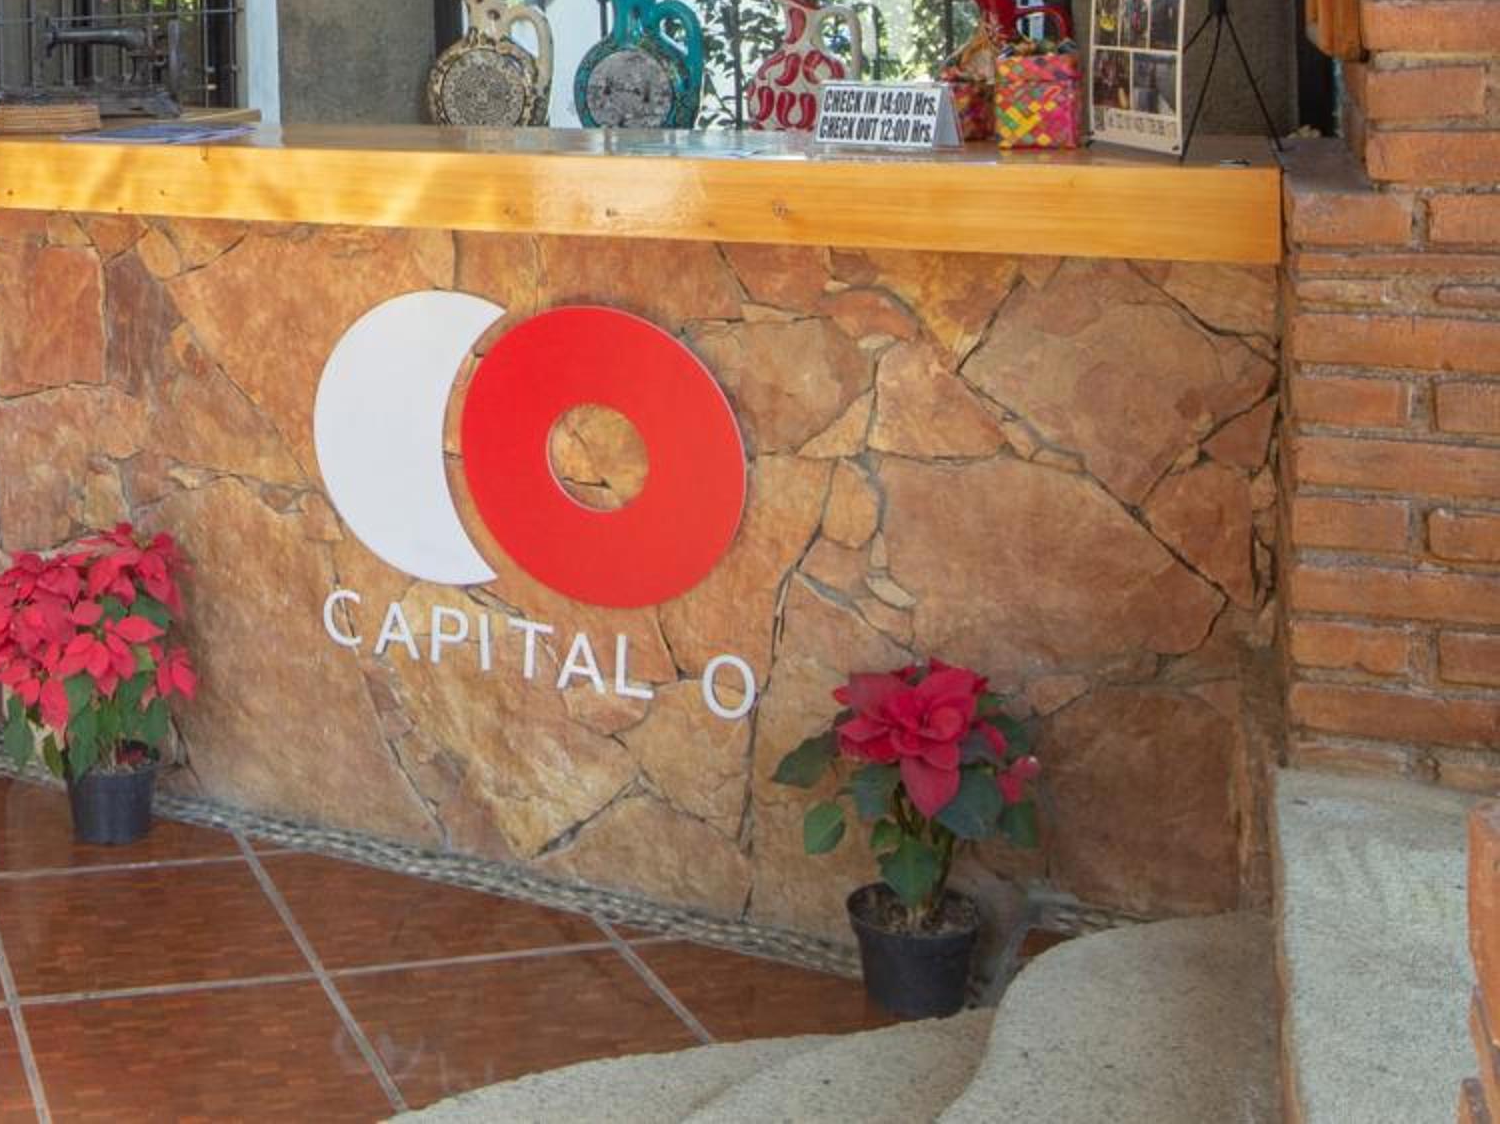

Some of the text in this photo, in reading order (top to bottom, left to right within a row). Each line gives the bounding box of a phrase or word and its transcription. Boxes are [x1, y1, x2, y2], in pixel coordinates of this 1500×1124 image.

[824, 90, 937, 116] CHECK IN 14:00 Hrs.
[819, 116, 933, 143] CHECK OUT 12:00 Hrs.
[322, 590, 756, 719] CAPITAL O
